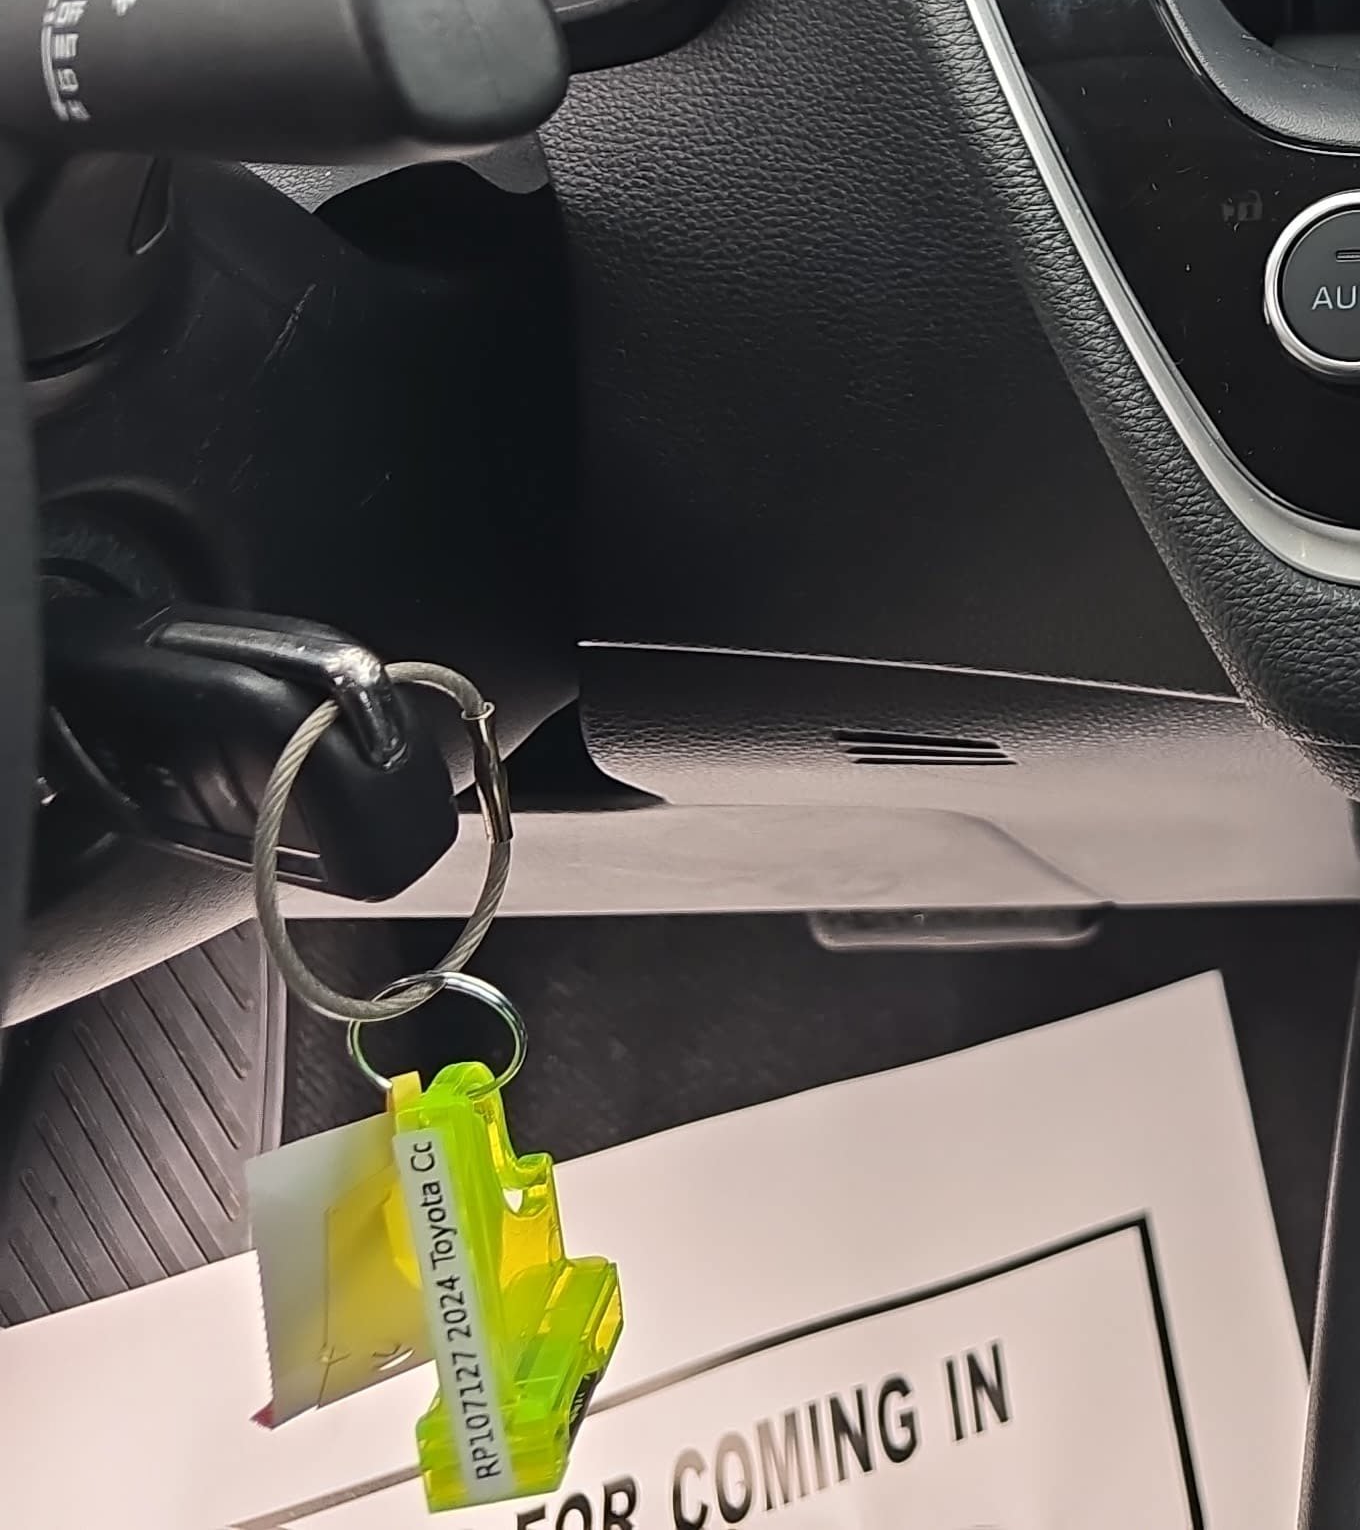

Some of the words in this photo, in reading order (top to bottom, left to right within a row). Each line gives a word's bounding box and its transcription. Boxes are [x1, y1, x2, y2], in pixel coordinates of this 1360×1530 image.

[424, 1180, 460, 1271] Toyota
[439, 1276, 472, 1343] 2024
[448, 1352, 502, 1481] RP107127
[672, 1371, 918, 1530] COMING
[944, 1339, 1010, 1443] IN
